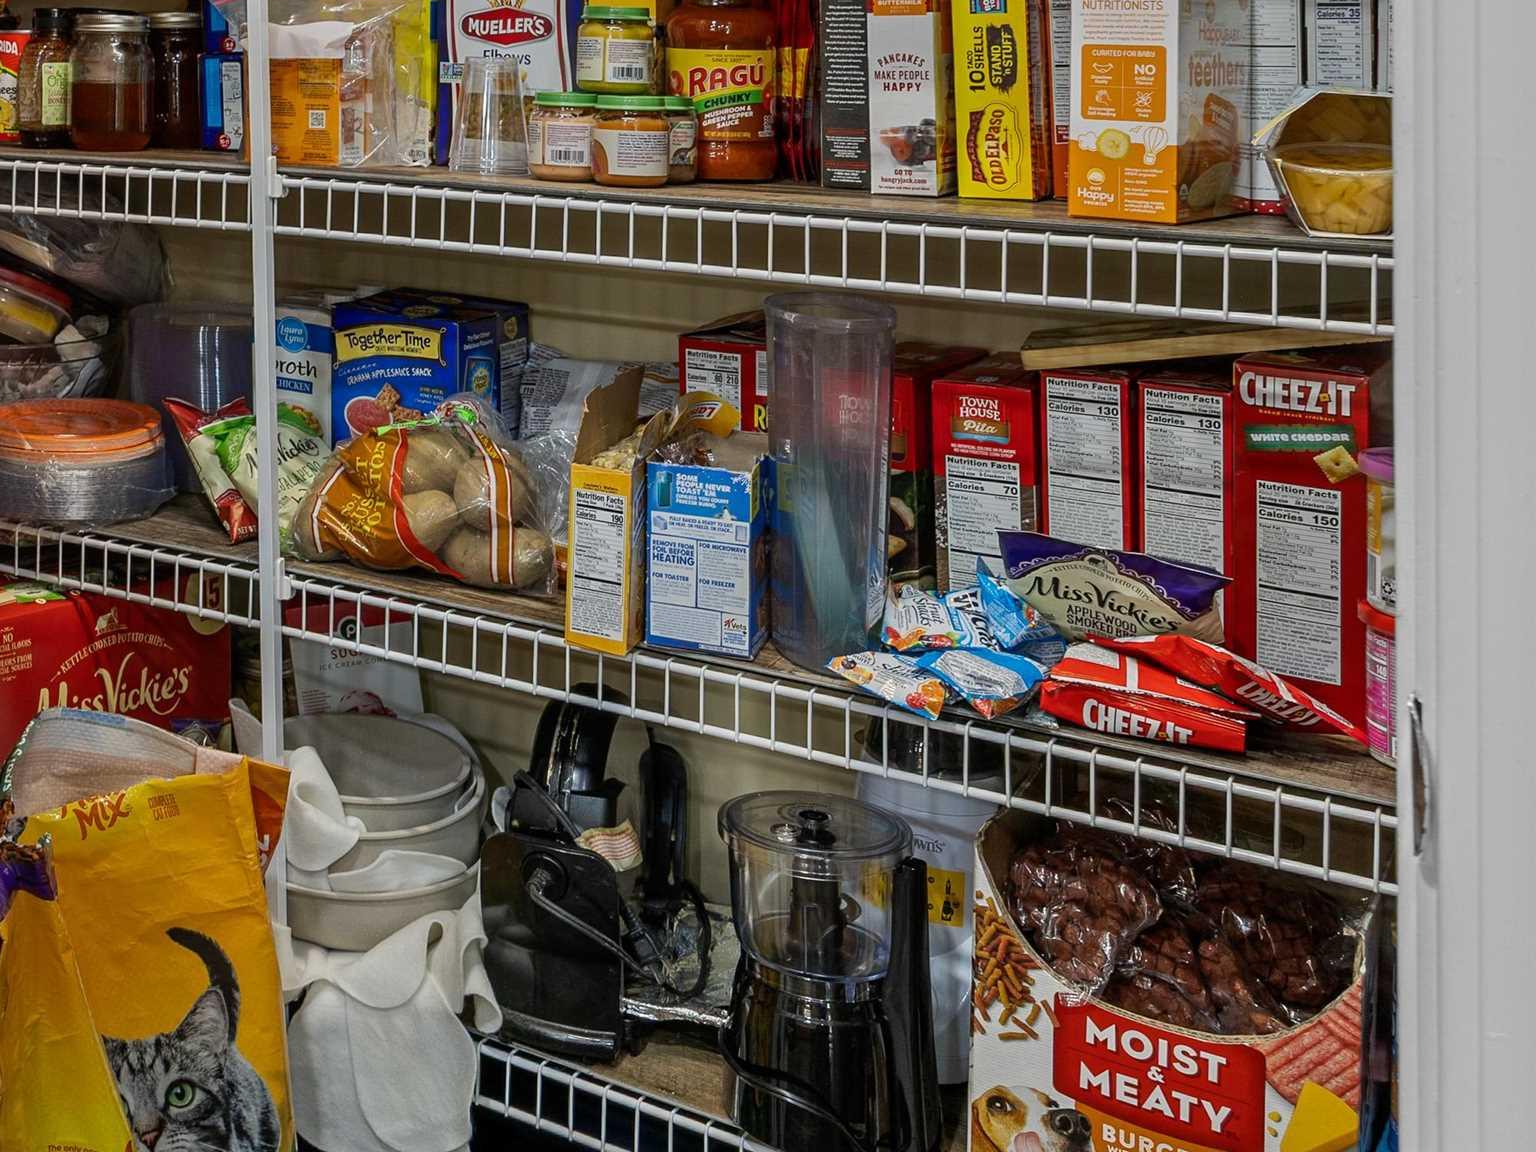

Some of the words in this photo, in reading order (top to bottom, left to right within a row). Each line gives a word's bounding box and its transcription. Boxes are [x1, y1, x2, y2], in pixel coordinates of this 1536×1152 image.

[1081, 0, 1164, 11] NUTRITIONISTS
[1316, 10, 1346, 19] Calories
[1348, 8, 1361, 18] 35
[467, 14, 548, 36] MUELLER'S
[876, 52, 926, 69] PANCAKES
[991, 45, 1002, 85] STAND
[688, 56, 765, 98] RAGÚ
[874, 69, 898, 82] MAKE
[899, 69, 931, 82] PEOPLE
[1134, 63, 1157, 76] NO
[882, 81, 922, 93] HAPPY
[703, 92, 751, 109] CHUNKY
[1077, 188, 1115, 203] Happy
[344, 328, 400, 351] Together
[400, 330, 432, 349] Time
[959, 396, 999, 410] TOWN
[959, 405, 1001, 421] HOUSE
[962, 418, 998, 434] Pita
[946, 456, 989, 469] Nutrition
[990, 460, 1017, 471] Facts
[948, 480, 985, 492] Calories
[1003, 485, 1018, 496] 70
[1258, 481, 1307, 496] Nutrition
[1308, 488, 1339, 500] Facts
[1258, 508, 1304, 523] Calories
[1311, 515, 1340, 527] 150
[652, 552, 696, 567] HEATING
[1025, 575, 1093, 605] Miss
[1086, 580, 1182, 634] Vickie's
[1067, 604, 1137, 635] APPLEWOOD
[95, 651, 193, 716] Vickie's
[72, 792, 131, 841] MIX
[1083, 1015, 1228, 1085] MOIST
[1146, 1065, 1166, 1084] &
[1078, 1060, 1232, 1137] MEATY
